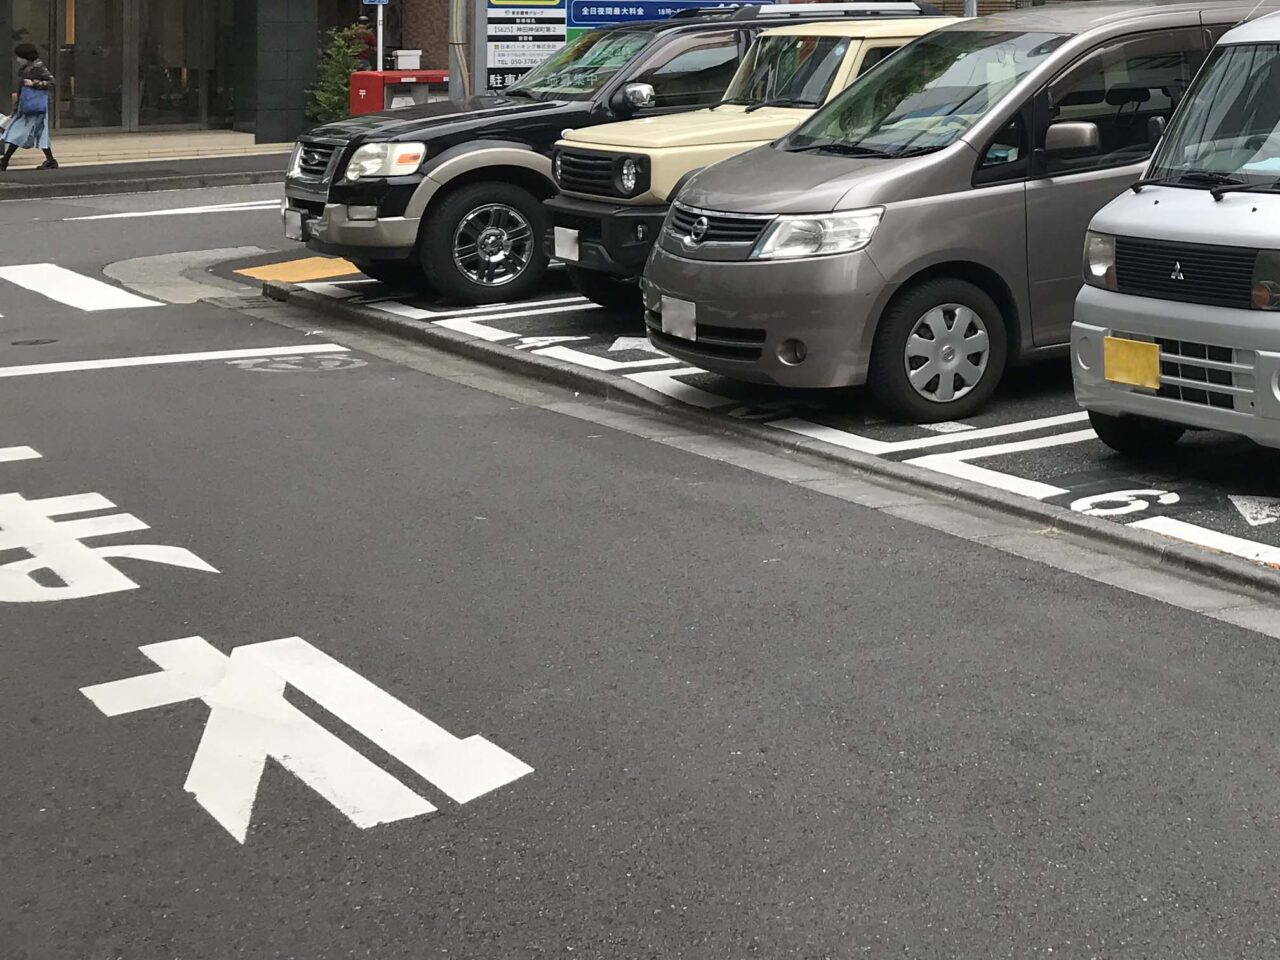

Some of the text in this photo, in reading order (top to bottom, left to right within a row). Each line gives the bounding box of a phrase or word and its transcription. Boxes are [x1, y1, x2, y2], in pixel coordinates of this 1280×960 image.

[582, 7, 645, 16] 全日夜間最大料金
[1070, 489, 1180, 517] 6
